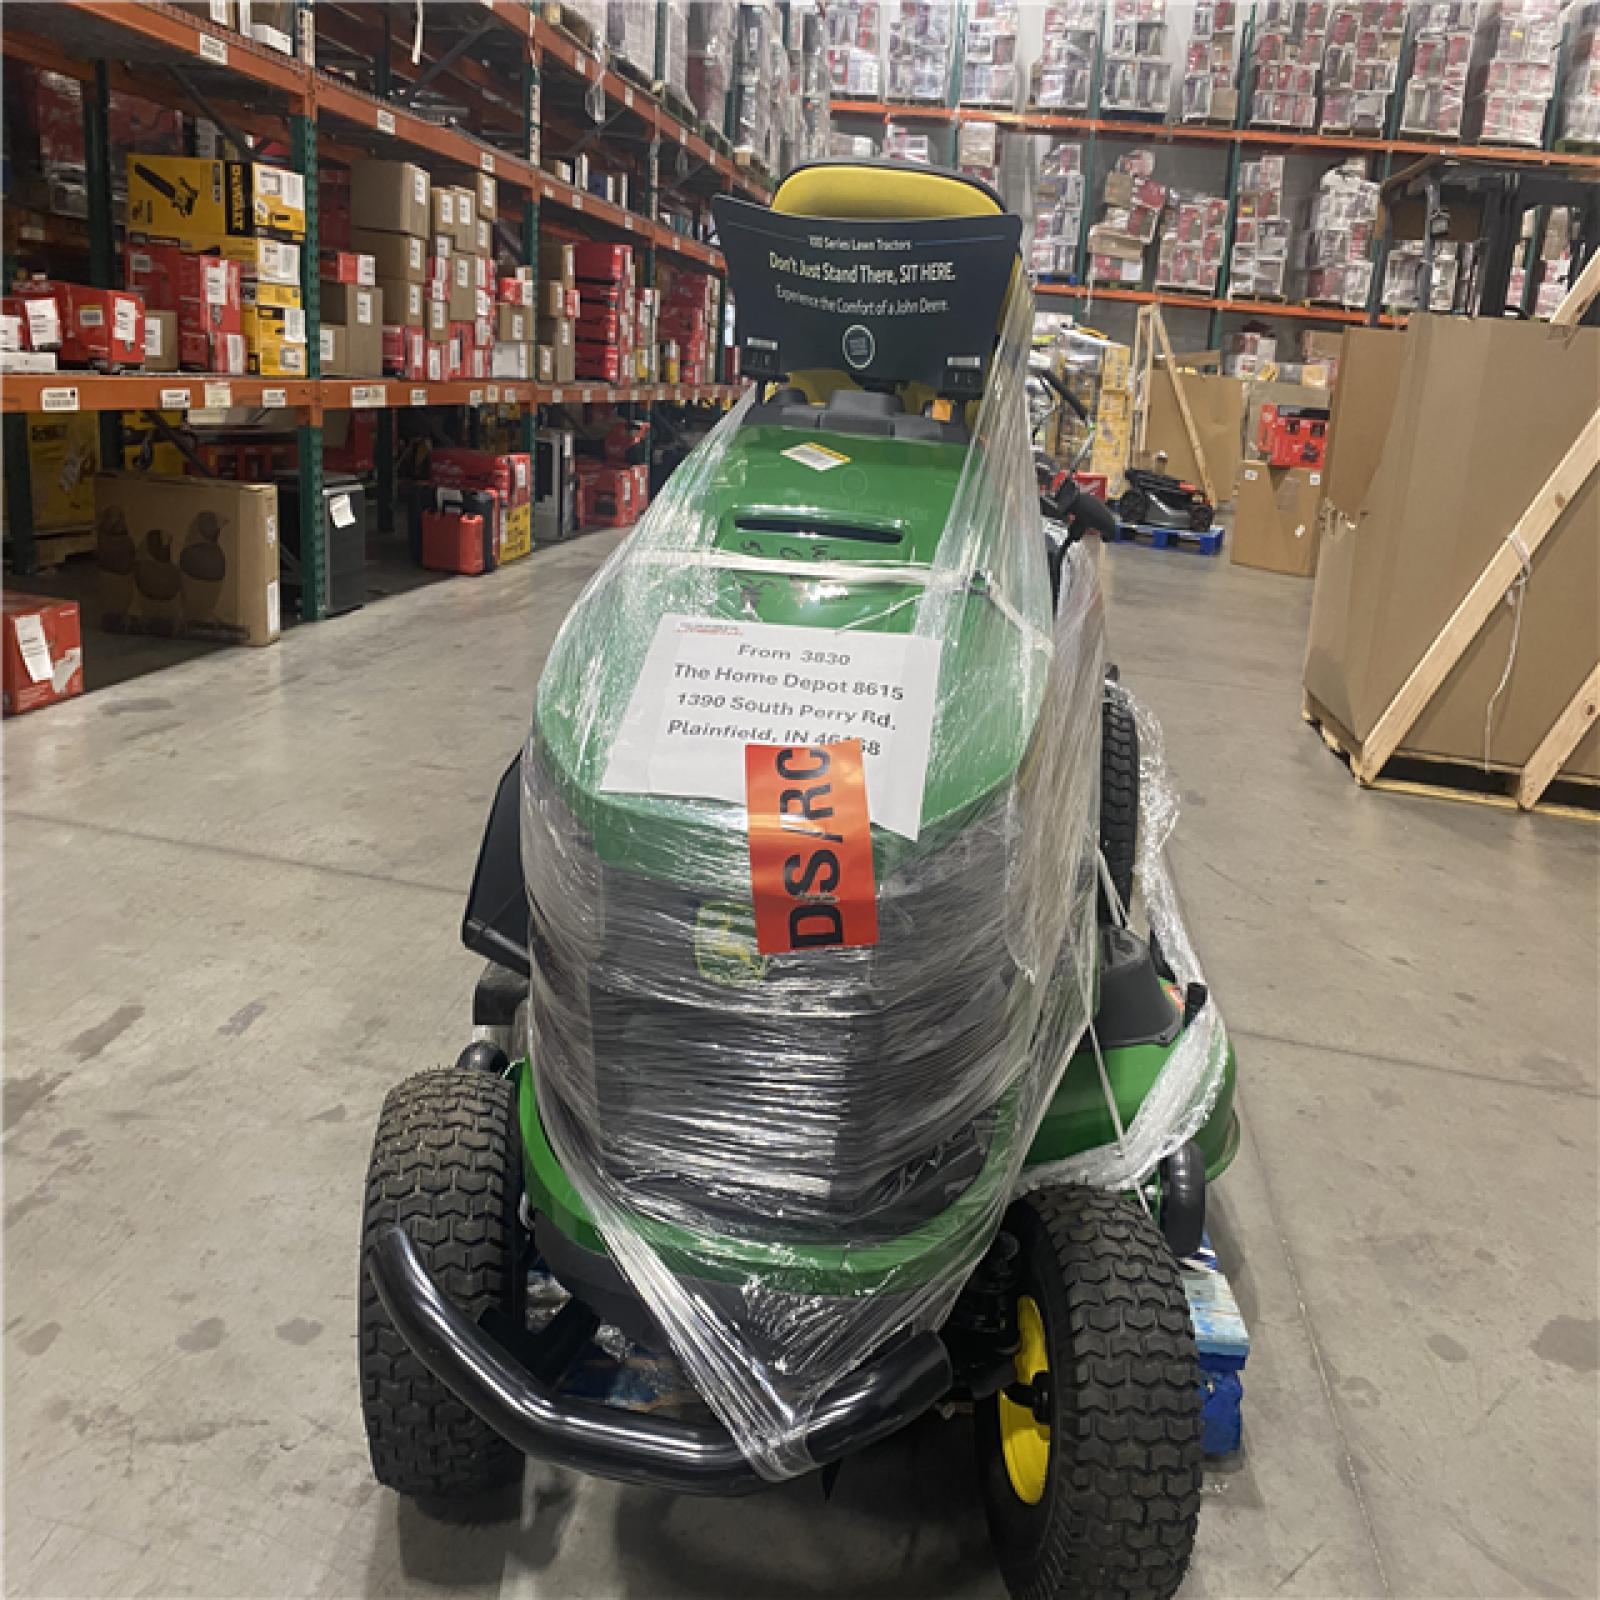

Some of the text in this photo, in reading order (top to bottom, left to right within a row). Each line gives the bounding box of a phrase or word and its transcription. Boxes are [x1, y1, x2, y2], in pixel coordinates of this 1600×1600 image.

[824, 236, 850, 250] Series
[852, 238, 875, 250] Lawn
[877, 236, 912, 251] Tractors
[769, 251, 798, 275] Don't
[800, 259, 821, 279] Just
[822, 262, 858, 283] Stand
[859, 264, 898, 286] There,
[899, 264, 919, 283] SIT
[776, 284, 818, 308] Experience
[820, 297, 836, 312] the
[837, 297, 874, 316] Comfort
[875, 299, 888, 316] of
[894, 299, 918, 315] John
[737, 643, 850, 666] From 3830
[674, 662, 904, 700] The Home Depot 8615
[678, 692, 726, 708] 1390
[730, 695, 793, 716] South
[800, 704, 856, 723] Perry
[667, 719, 778, 743] Plainfield,
[785, 730, 809, 743] IN
[776, 747, 844, 949] DS/RC
